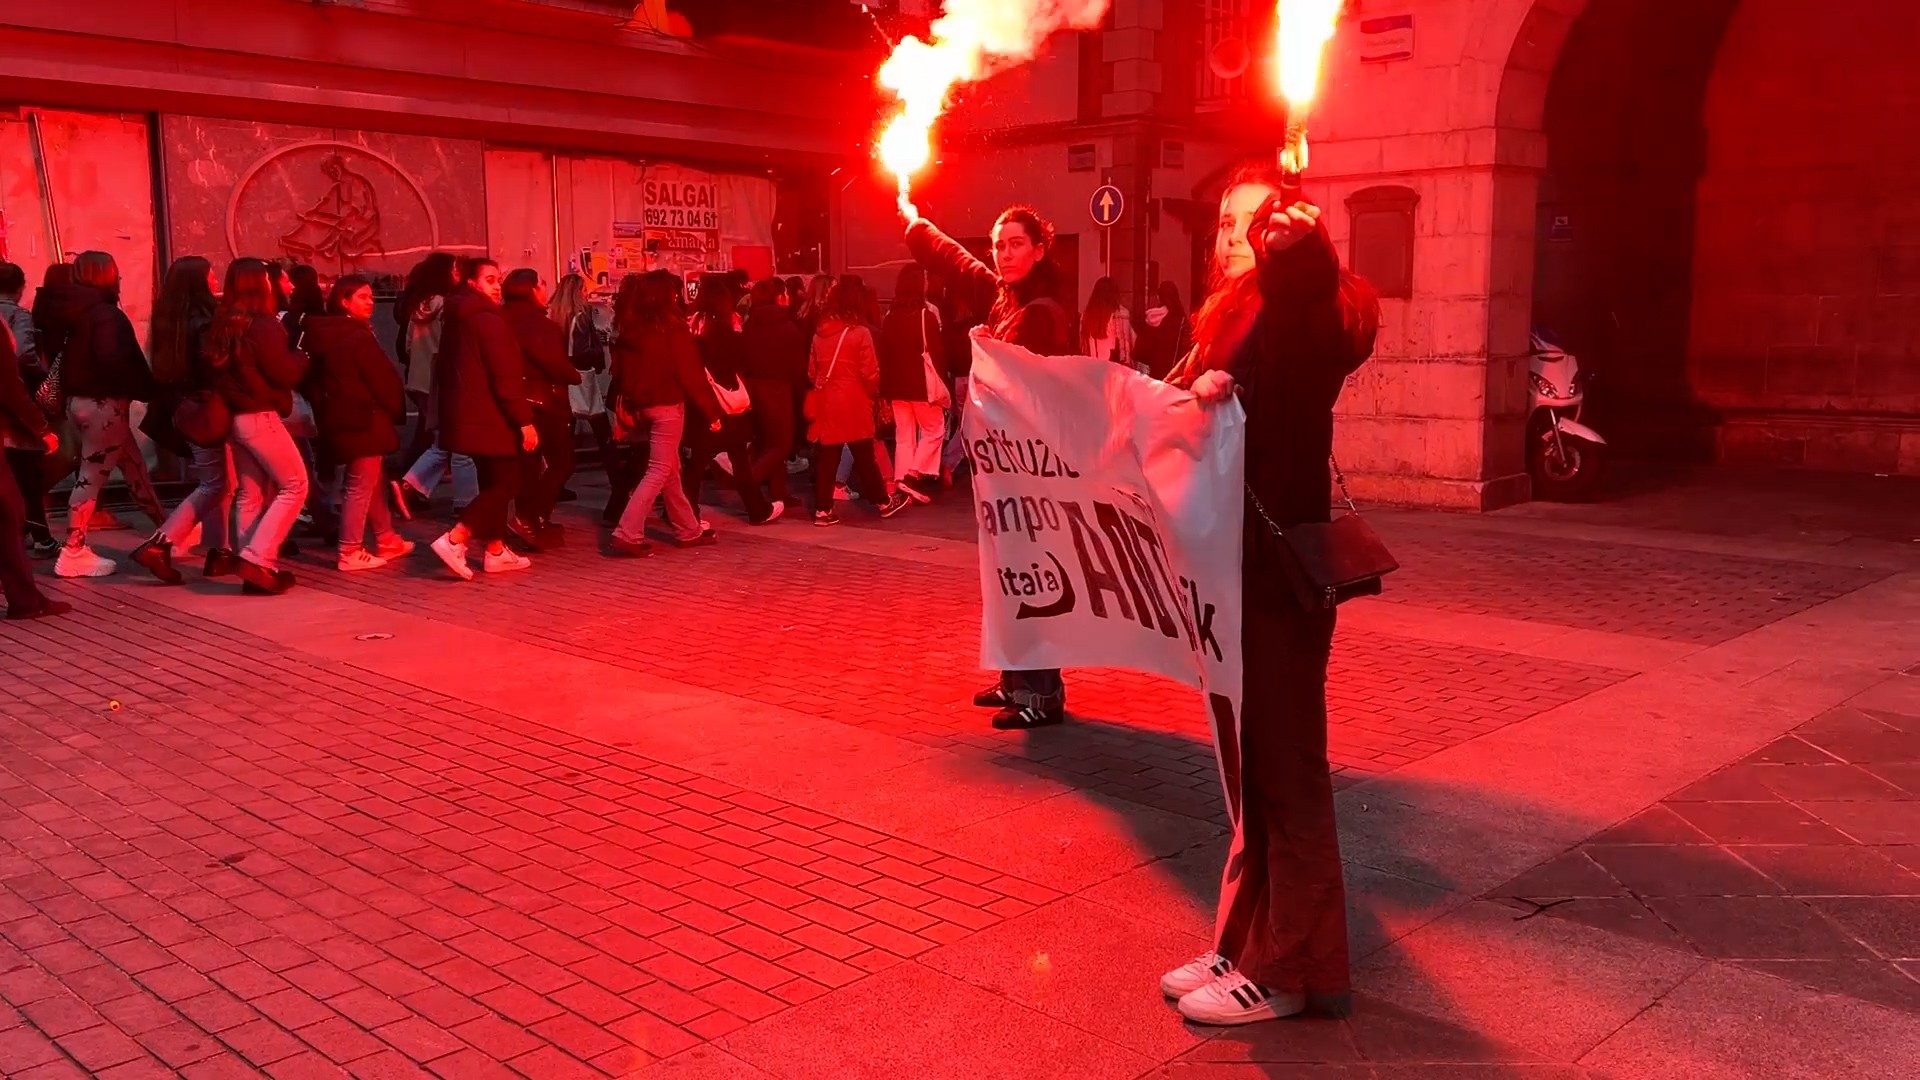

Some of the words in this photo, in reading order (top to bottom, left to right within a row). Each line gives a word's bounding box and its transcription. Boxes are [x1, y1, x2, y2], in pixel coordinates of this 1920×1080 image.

[645, 181, 715, 208] SALGAI
[645, 208, 667, 226] 692
[670, 209, 684, 227] 73
[687, 210, 701, 228] 04
